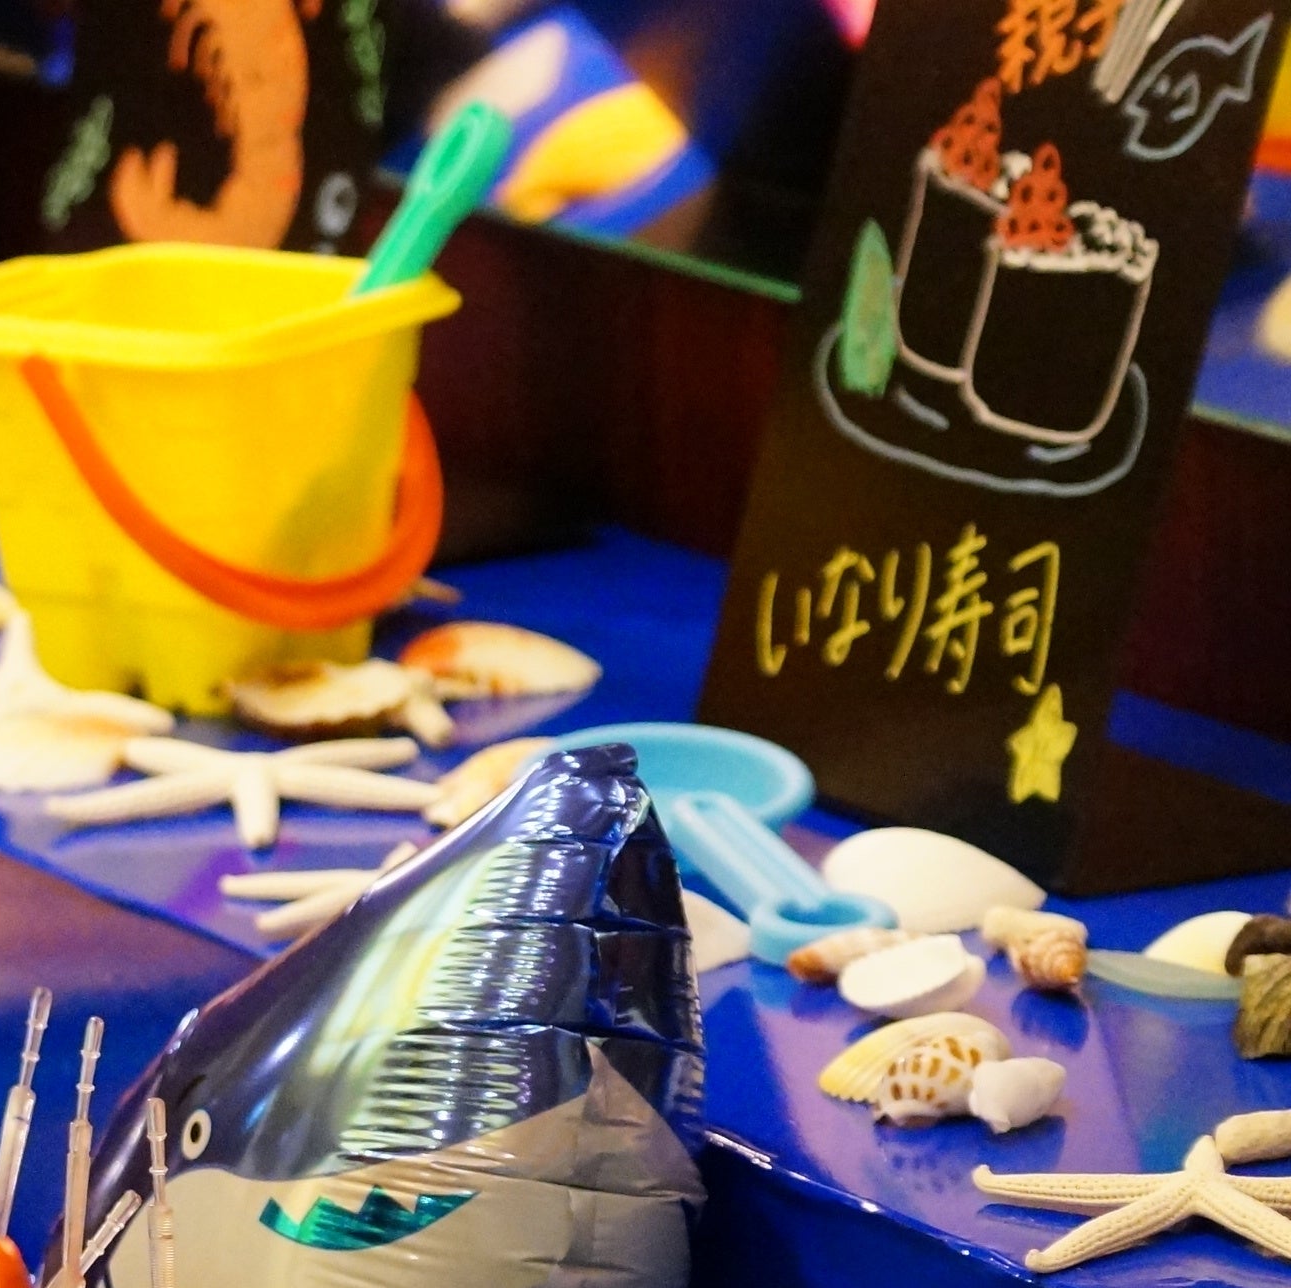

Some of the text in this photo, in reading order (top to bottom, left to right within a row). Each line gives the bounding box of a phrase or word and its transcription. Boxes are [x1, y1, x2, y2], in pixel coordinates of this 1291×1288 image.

[755, 522, 1059, 695] いなり寿司
